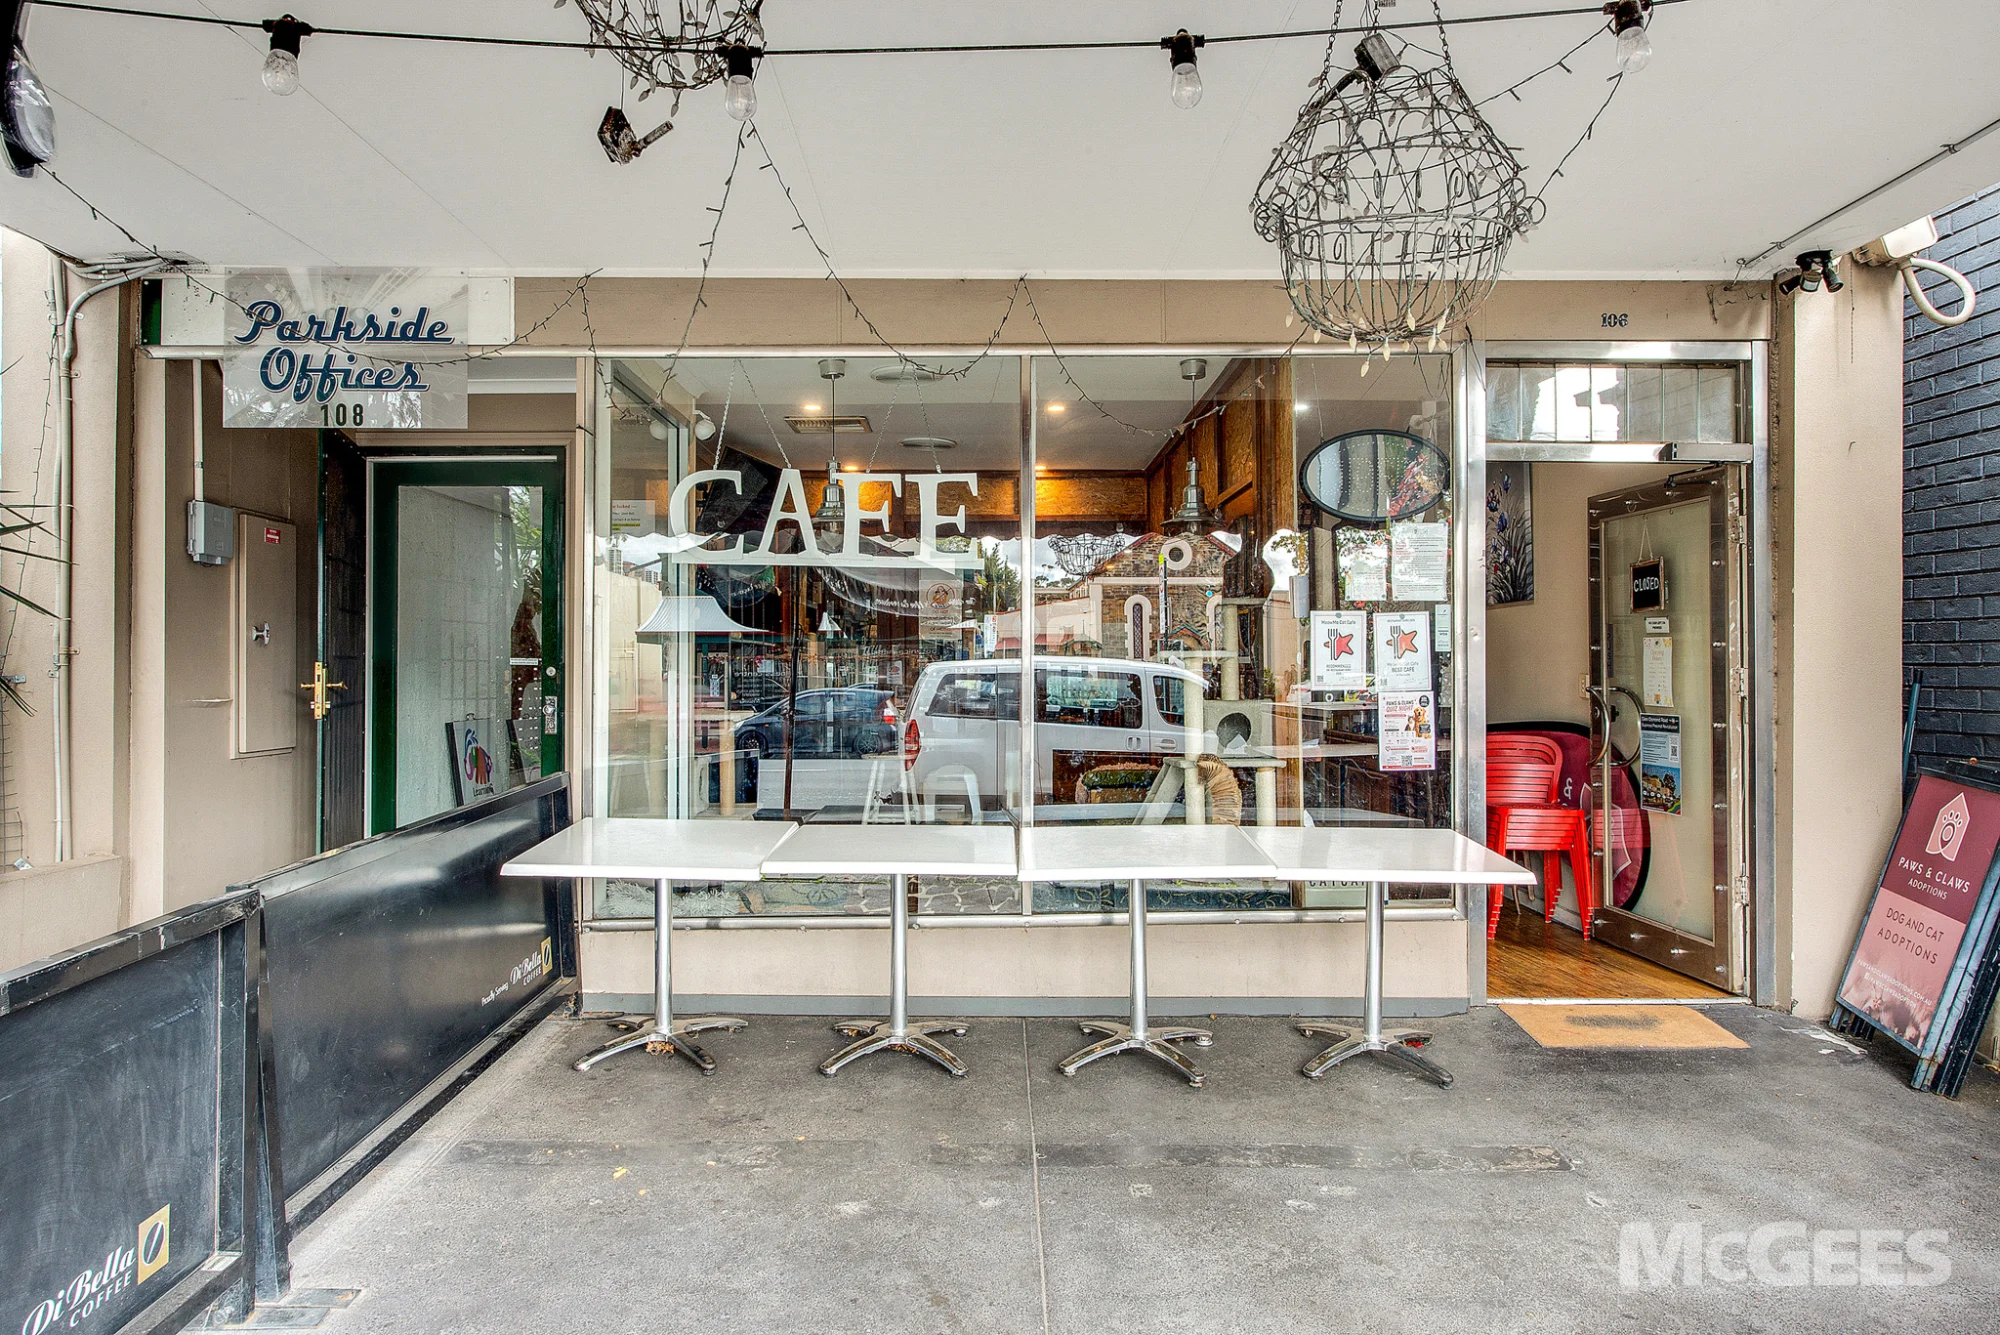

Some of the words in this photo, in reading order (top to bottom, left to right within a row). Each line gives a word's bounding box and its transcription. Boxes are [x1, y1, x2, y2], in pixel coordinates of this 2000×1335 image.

[233, 299, 455, 345] Parkside
[1600, 312, 1629, 328] 106
[258, 346, 430, 403] Offices
[319, 403, 364, 427] 108
[669, 468, 979, 560] CAFE
[1633, 576, 1660, 593] CLOSED
[1898, 856, 1924, 875] PAWS
[1925, 867, 1933, 879] &
[1935, 871, 1971, 893] CLAWS
[1907, 878, 1948, 900] ADOPTIONS
[1886, 907, 1906, 925] DOG
[1905, 917, 1925, 934] AND
[1925, 926, 1945, 943] CAT
[1877, 927, 1938, 965] ADOPTIONS
[523, 965, 542, 986] COFFEE
[69, 1269, 134, 1329] COFFEE
